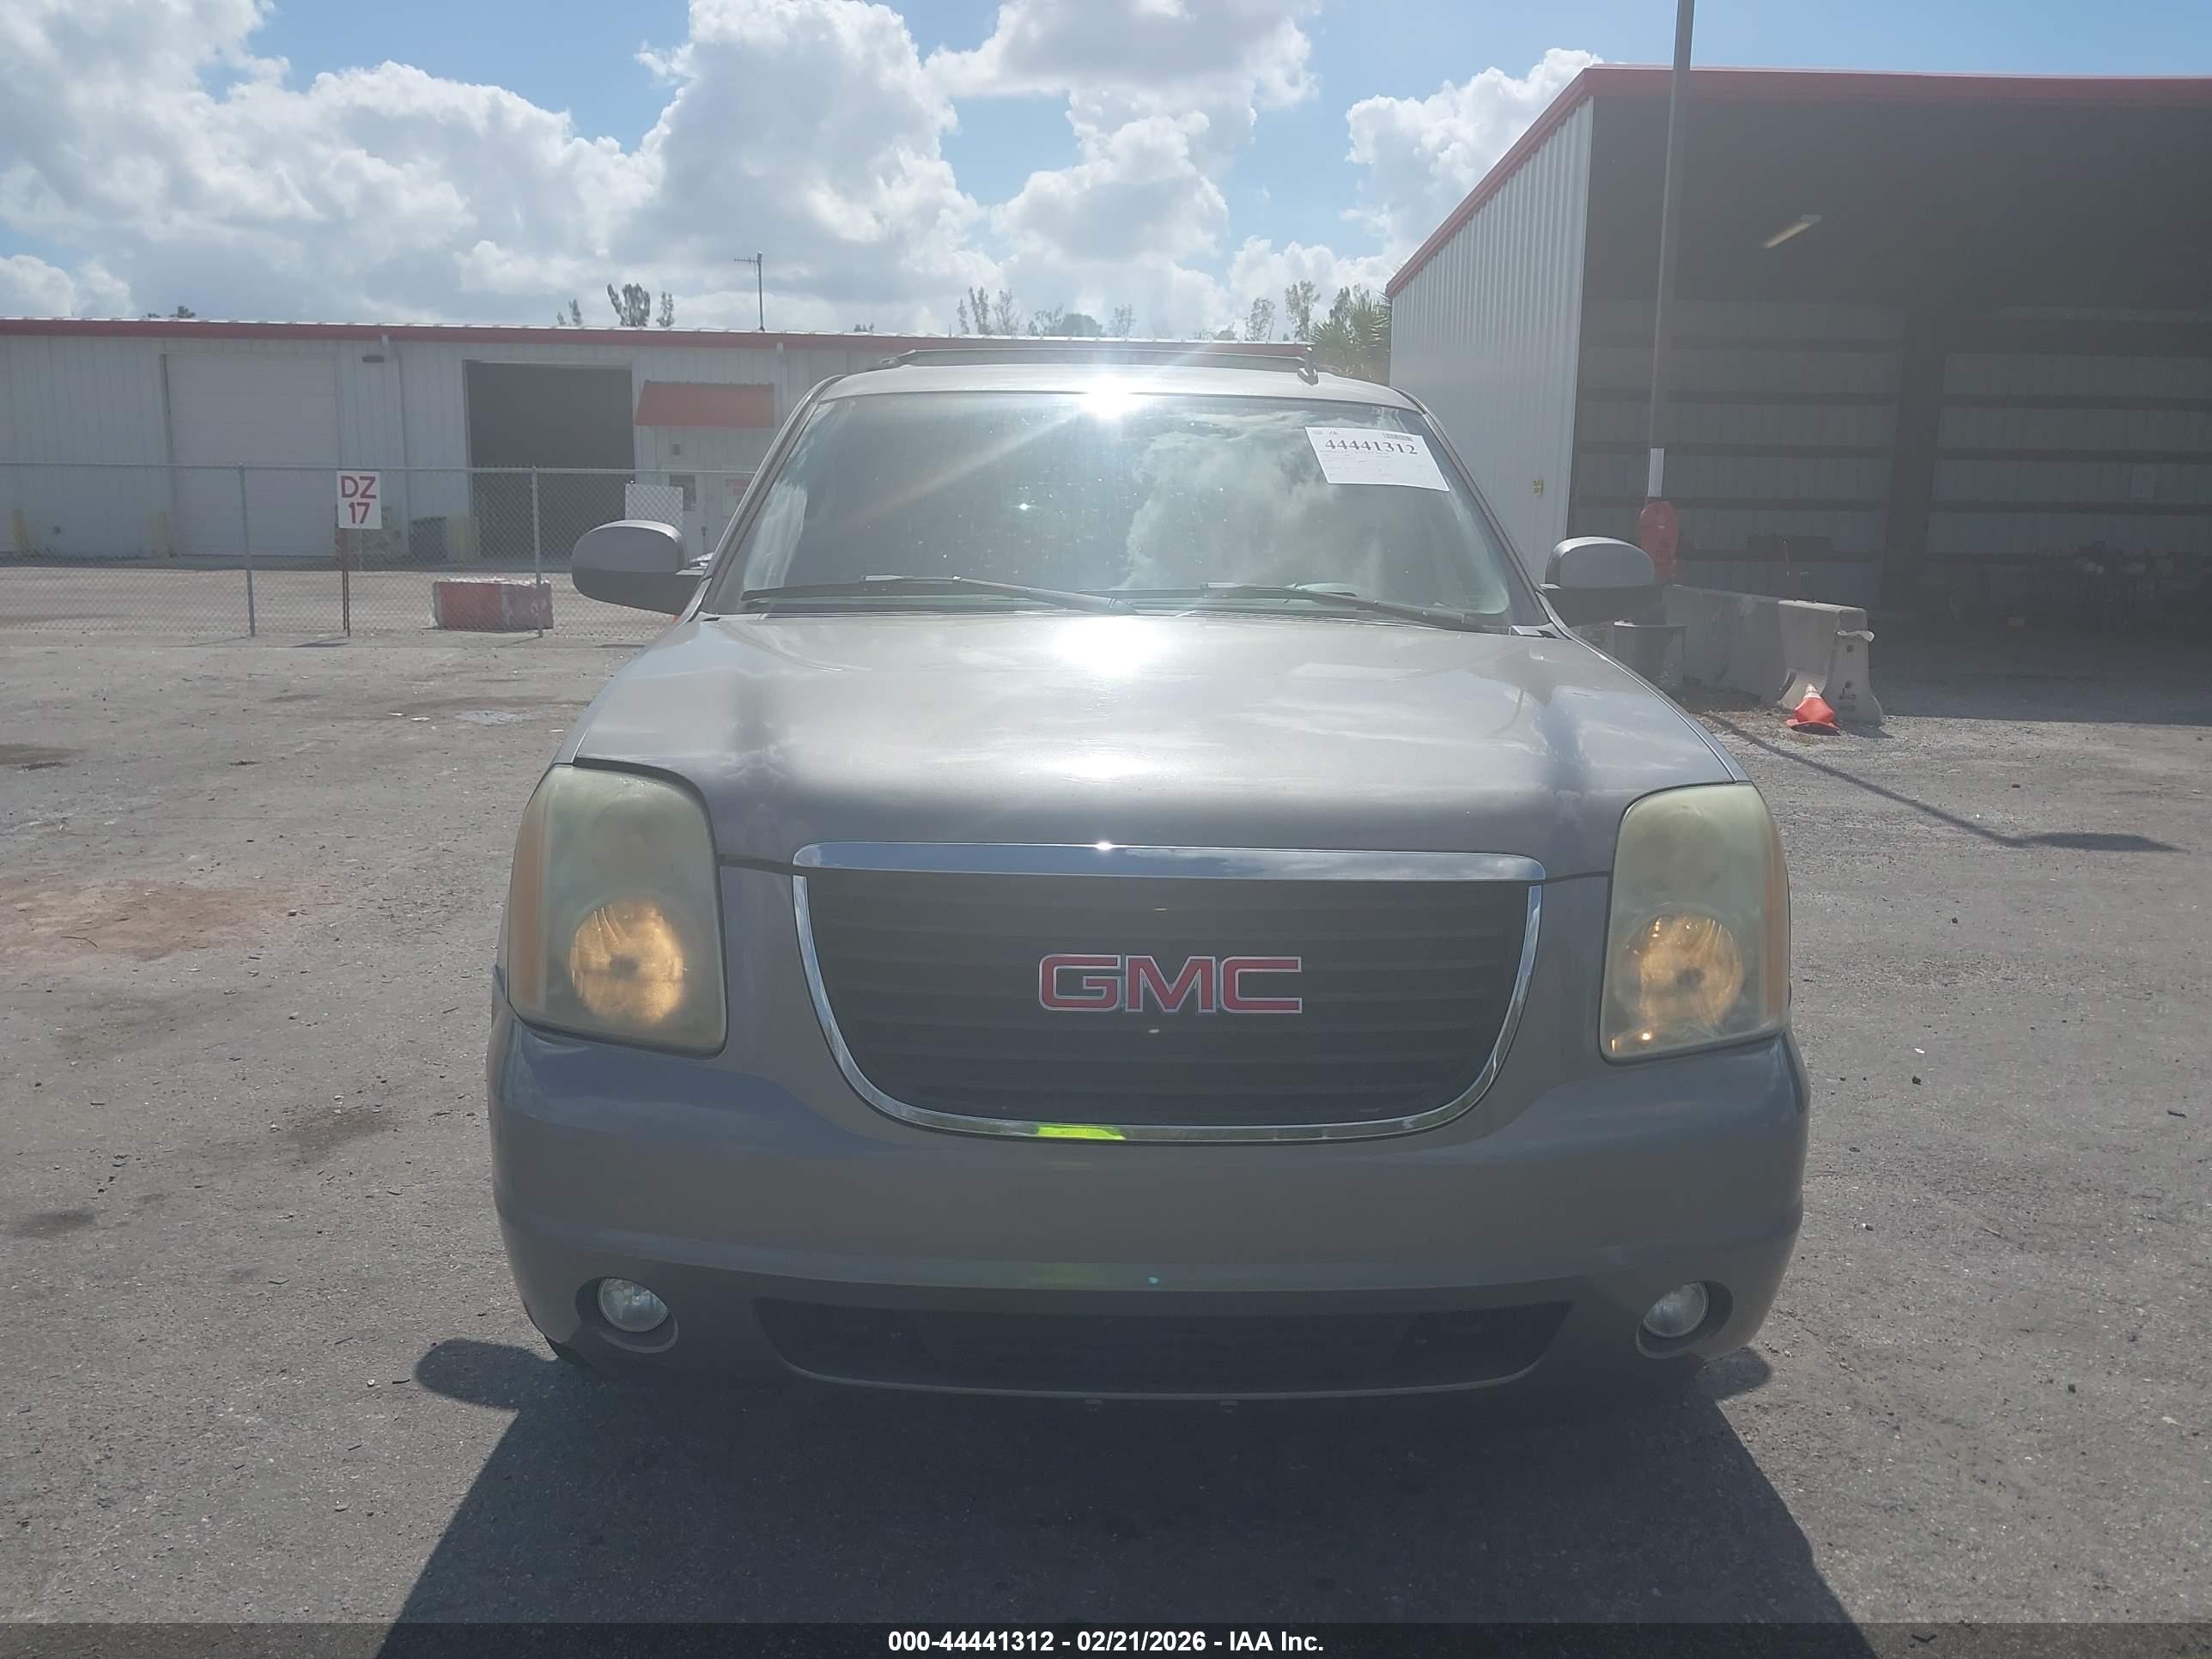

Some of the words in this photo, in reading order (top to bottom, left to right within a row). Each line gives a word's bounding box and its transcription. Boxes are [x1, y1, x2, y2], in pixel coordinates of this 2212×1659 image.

[1325, 439, 1419, 455] 44441312
[340, 475, 377, 499] DZ
[349, 501, 371, 524] 17
[1038, 953, 1303, 1014] GMC
